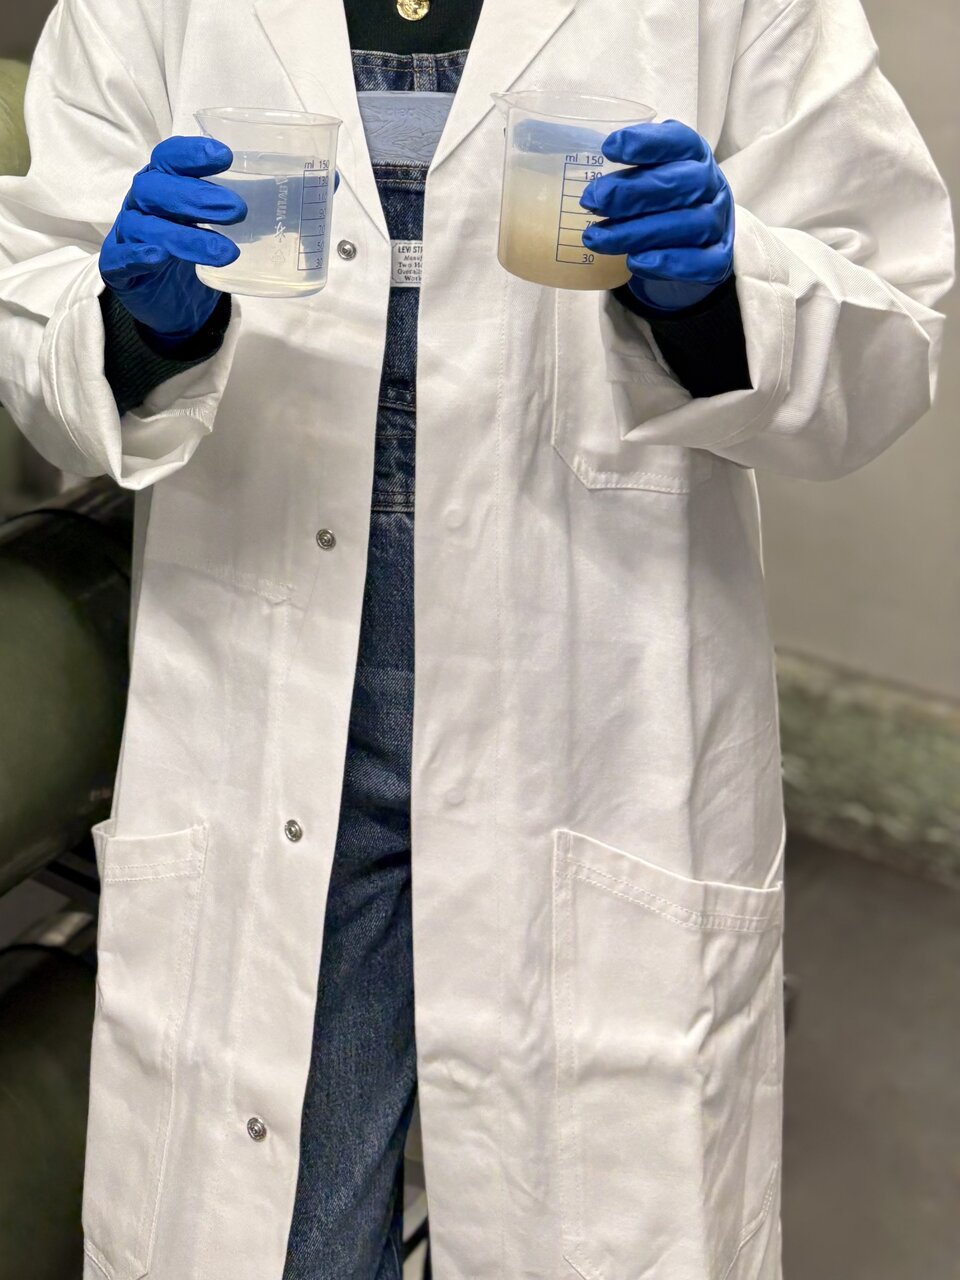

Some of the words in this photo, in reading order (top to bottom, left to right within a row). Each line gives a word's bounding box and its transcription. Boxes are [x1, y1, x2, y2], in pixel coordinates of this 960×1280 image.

[565, 154, 578, 163] ml
[586, 155, 604, 165] 150
[582, 254, 595, 263] 30
